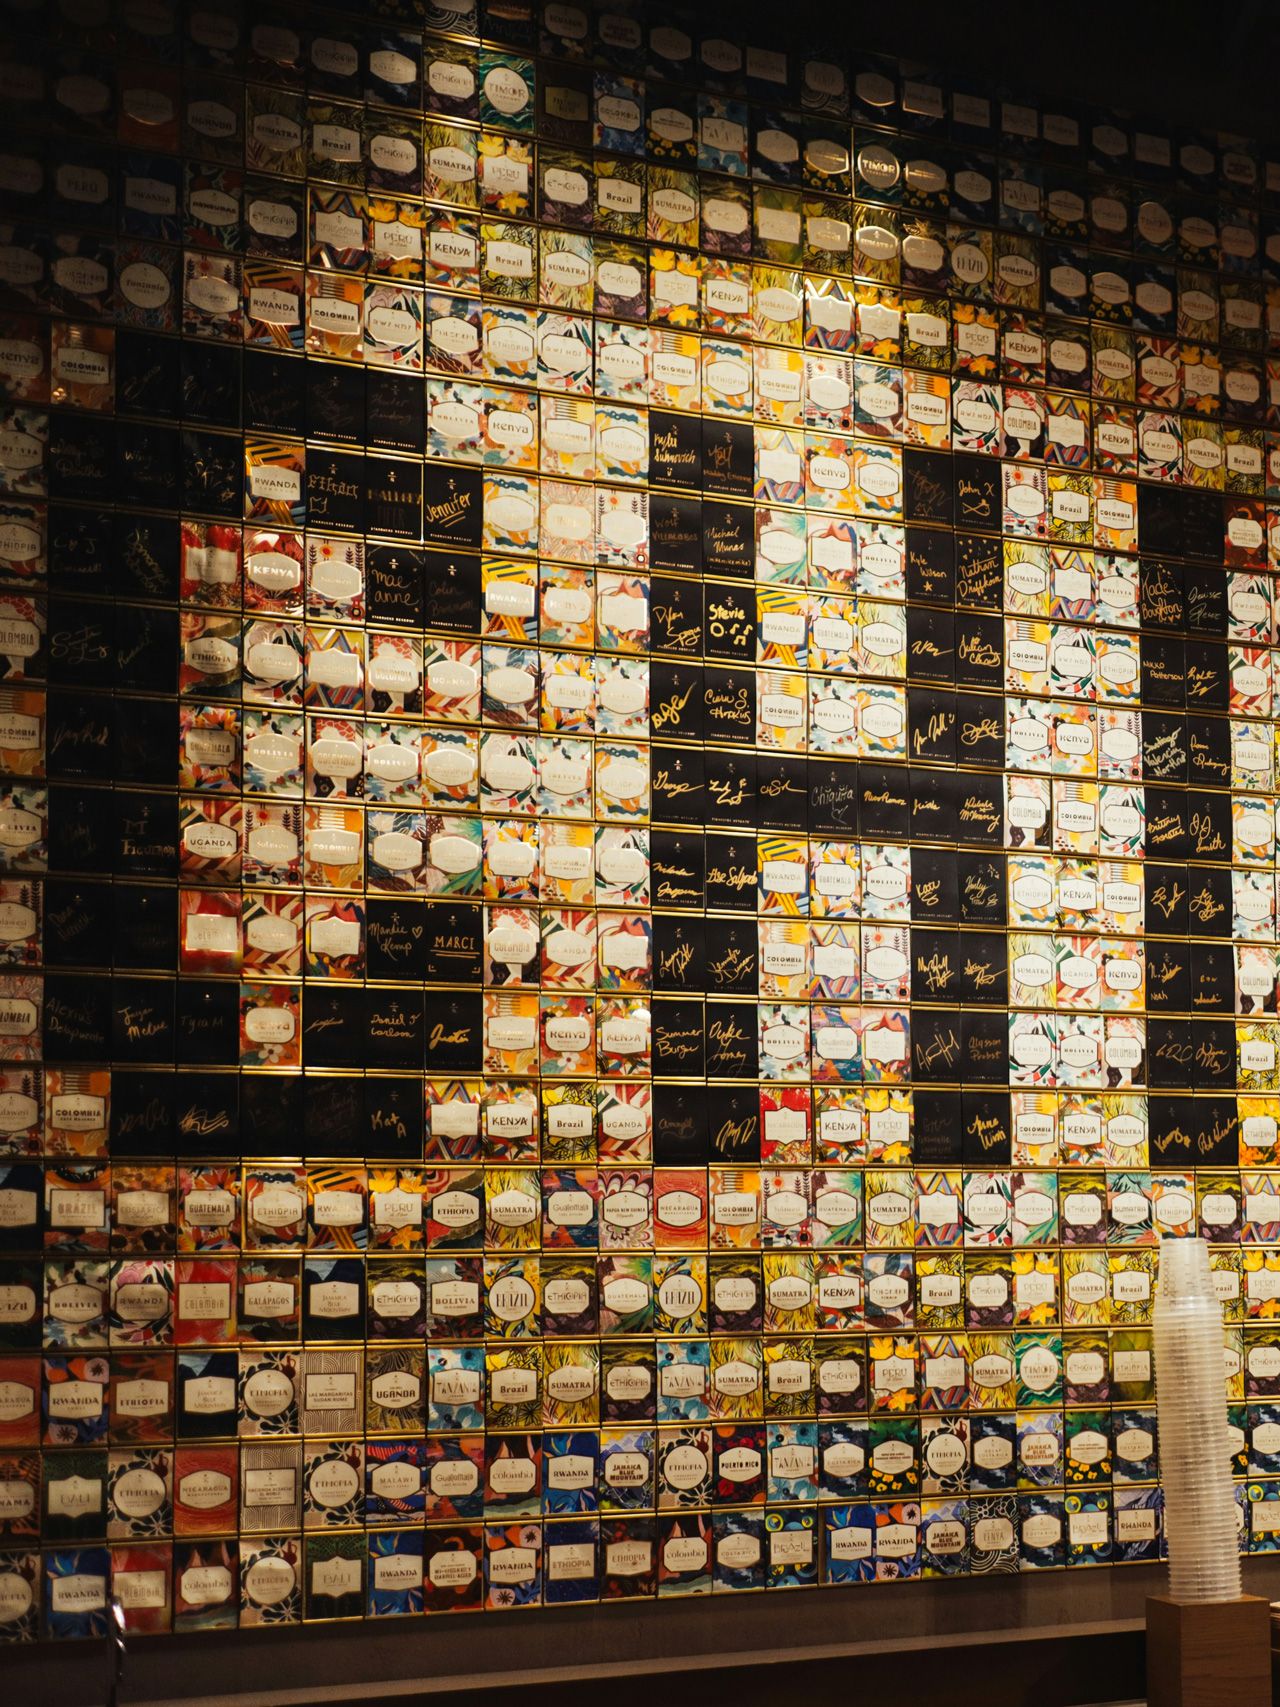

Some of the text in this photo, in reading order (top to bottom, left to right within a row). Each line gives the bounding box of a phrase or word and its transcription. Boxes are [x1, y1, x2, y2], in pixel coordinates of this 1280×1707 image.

[484, 85, 525, 98] TIMOR
[322, 138, 350, 150] Brazil
[433, 159, 472, 171] SUMATRA
[607, 193, 632, 204] Brazil
[435, 244, 470, 256] KENYA
[548, 265, 585, 275] SUMATRA
[712, 291, 743, 302] KENYA
[254, 300, 295, 311] RWANDA
[314, 310, 354, 320] COLOMBIA
[916, 328, 939, 338] Brazil
[1009, 342, 1038, 353] KENYA
[61, 361, 105, 372] COLOMBIA
[657, 365, 692, 374] COLOMBIA
[1145, 367, 1173, 379] UGANDA
[912, 405, 942, 414] COLOMBIA
[1008, 418, 1036, 430] COLOMBIA
[1102, 434, 1129, 444] KENYA
[1190, 450, 1219, 458] SUMATRA
[256, 478, 296, 489] RWANDA
[426, 492, 470, 523] Jennifer
[1060, 505, 1081, 513] Brazil
[253, 566, 294, 578] KENYA
[1012, 574, 1042, 585] SUMATRA
[1238, 678, 1262, 687] UGANDA
[190, 839, 232, 849] UGANDA
[492, 1117, 527, 1125] KENYA
[825, 1122, 856, 1130] KENYA
[384, 1204, 412, 1213] PERU
[777, 1376, 802, 1384] Brazil
[376, 1390, 415, 1398] UGANDA
[500, 1385, 528, 1394] Brazil
[380, 1570, 417, 1578] RWANDA
